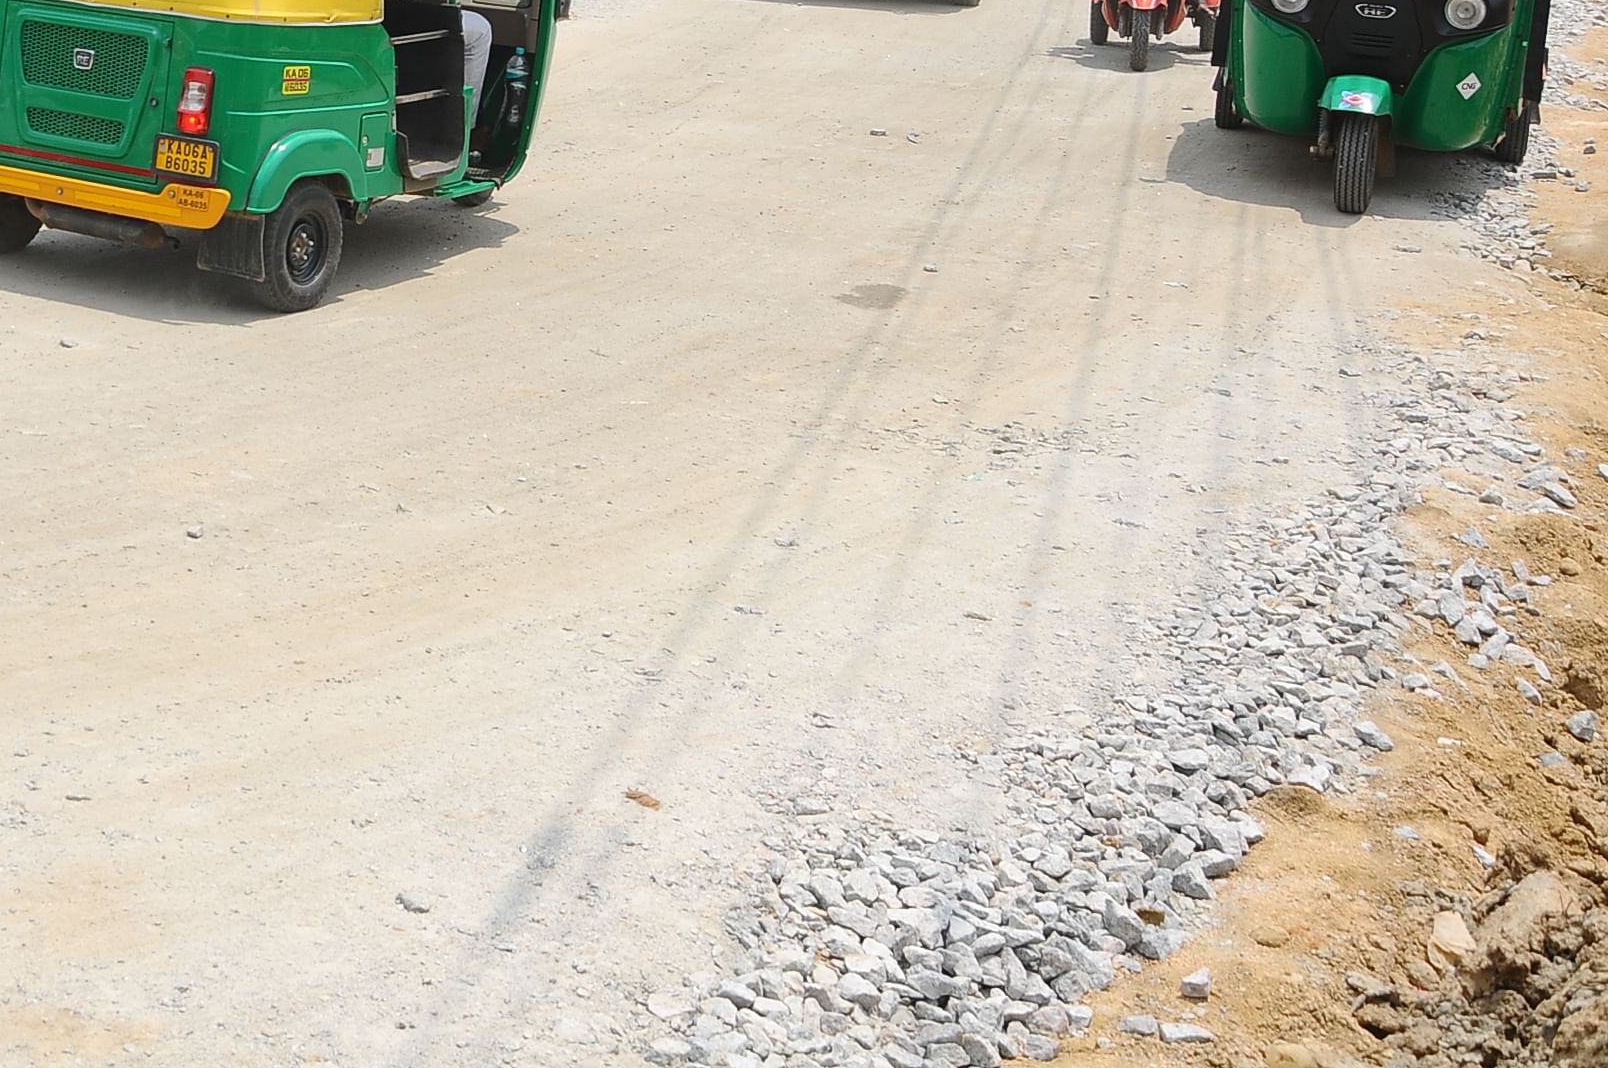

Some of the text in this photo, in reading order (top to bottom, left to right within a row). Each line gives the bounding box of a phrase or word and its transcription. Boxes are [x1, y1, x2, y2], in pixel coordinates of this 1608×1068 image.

[285, 68, 296, 78] KA
[1461, 82, 1478, 90] CNG
[167, 140, 208, 159] KA06A
[166, 156, 207, 175] B6035
[183, 188, 204, 198] KA-06
[178, 198, 207, 210] AB-6035
